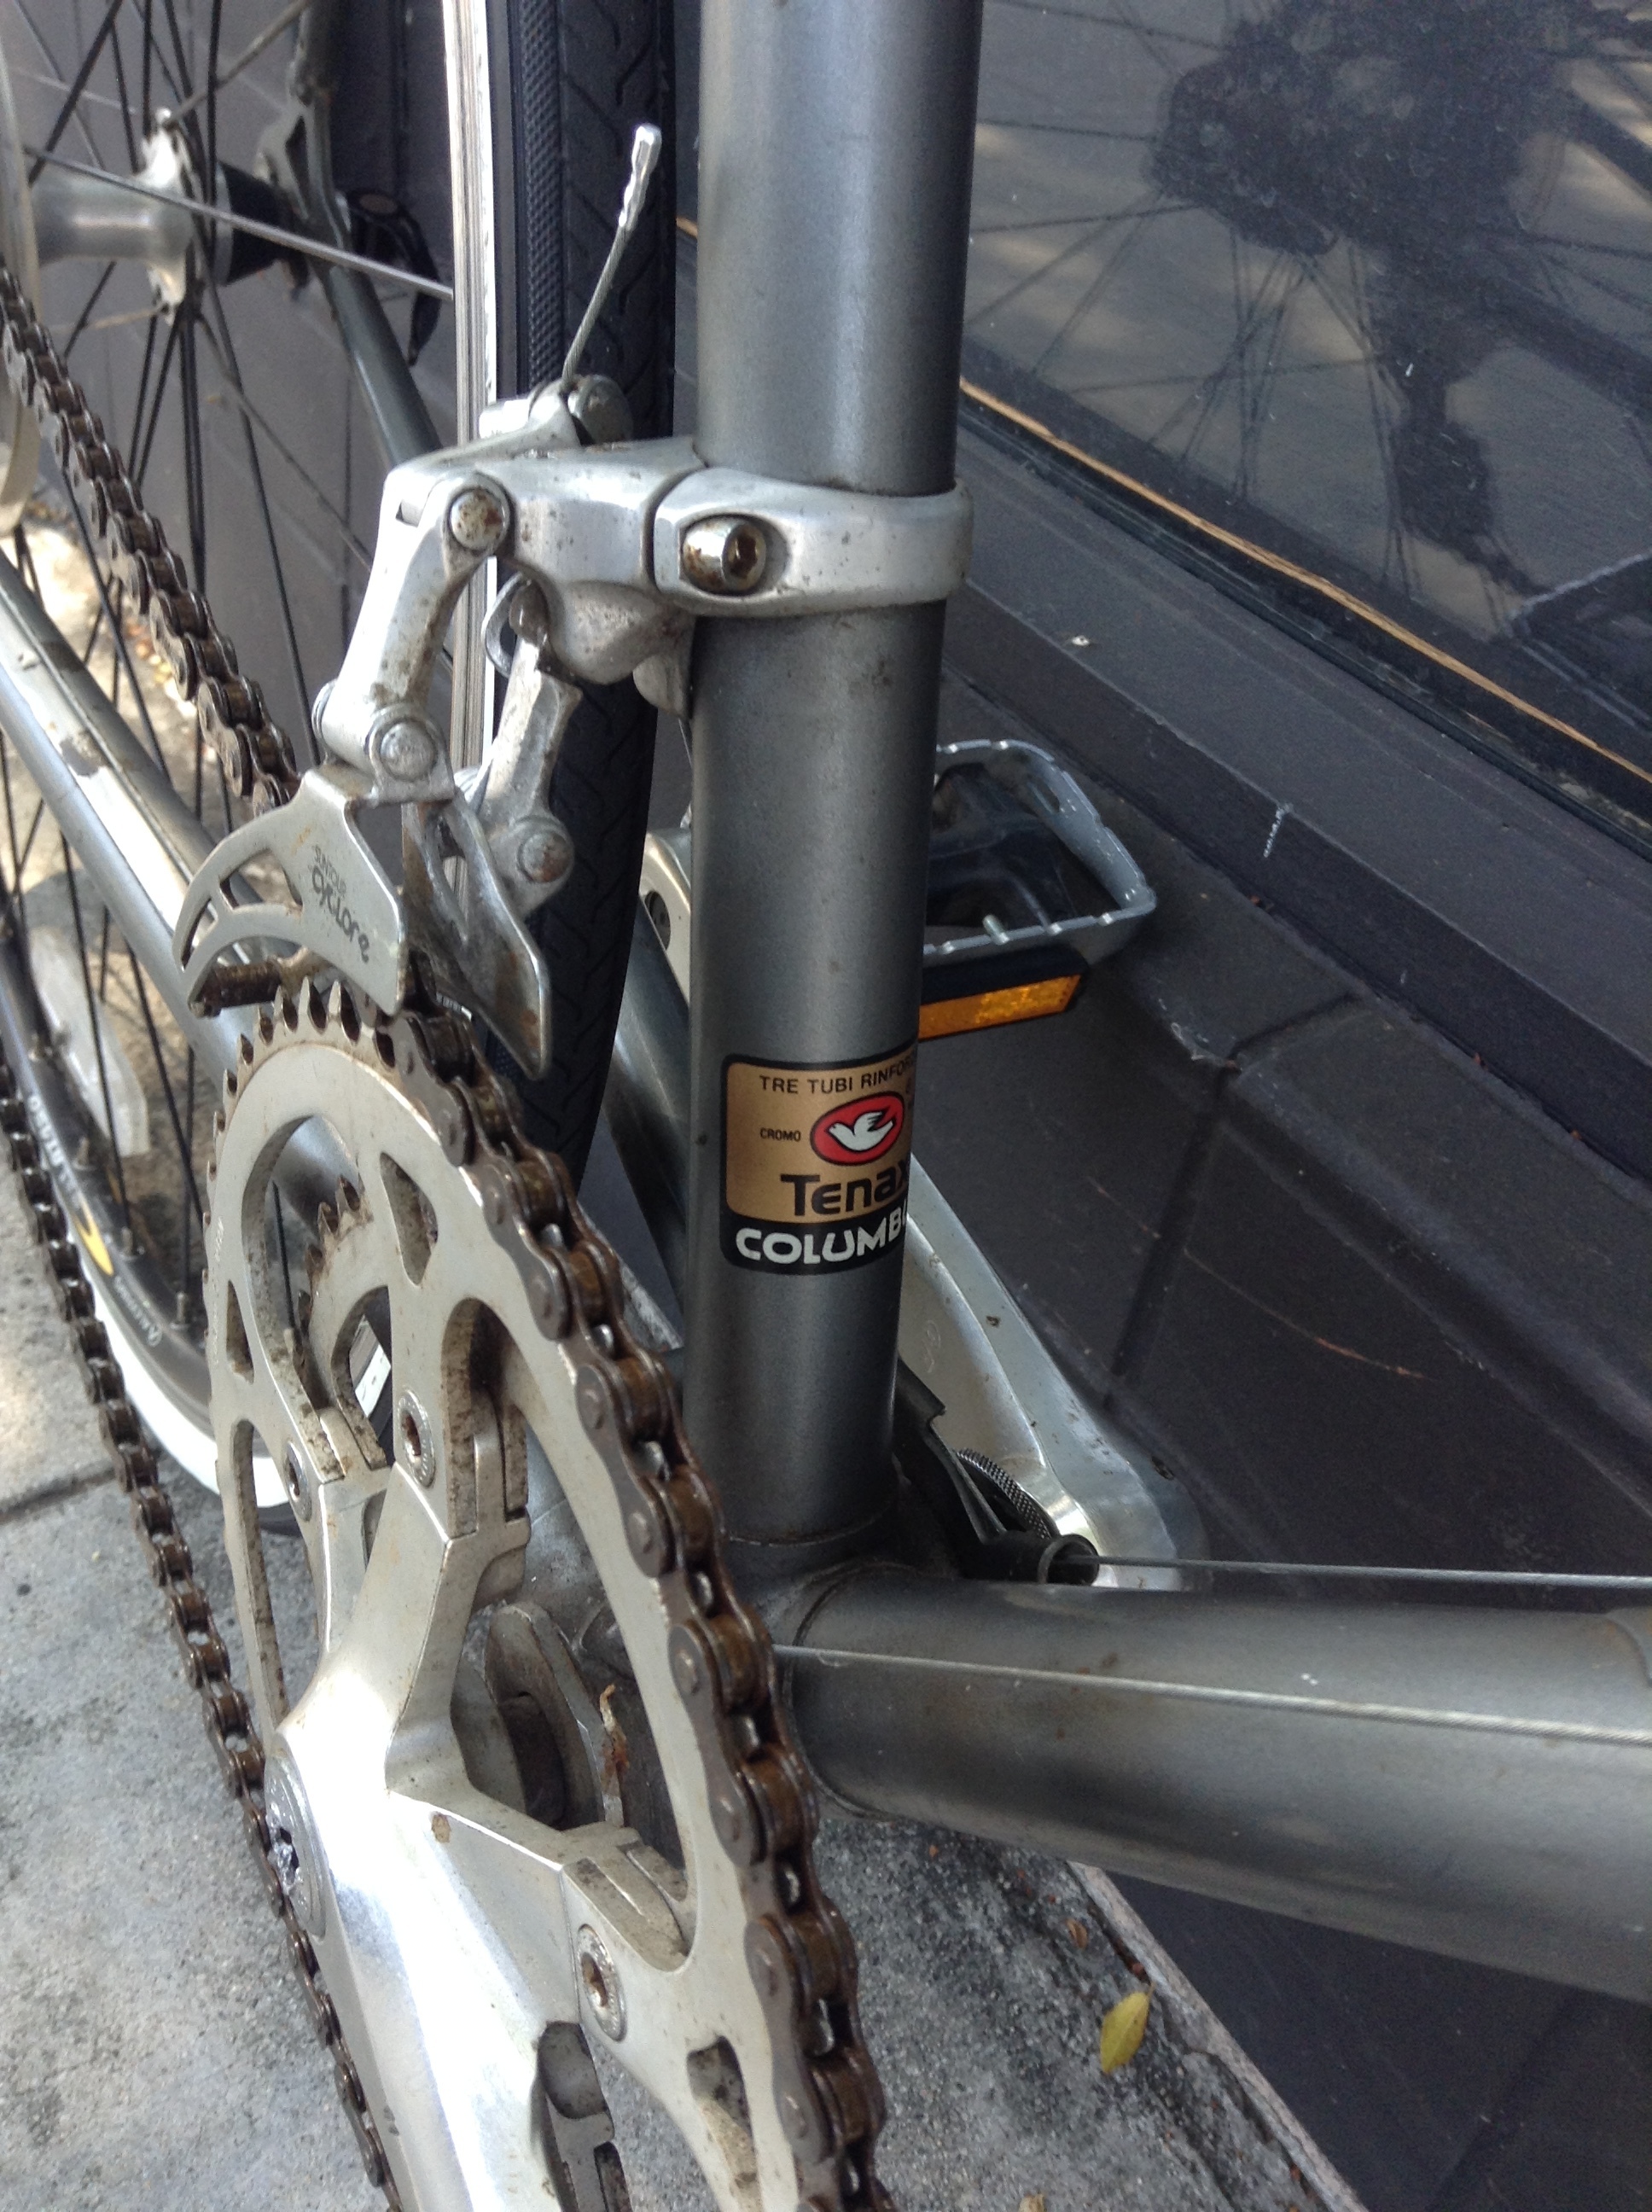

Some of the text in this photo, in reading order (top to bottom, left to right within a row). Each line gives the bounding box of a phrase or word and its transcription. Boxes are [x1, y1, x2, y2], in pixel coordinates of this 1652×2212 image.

[759, 1074, 799, 1094] TRE
[807, 1076, 853, 1094] TUBI
[759, 1127, 801, 1143] CROMO
